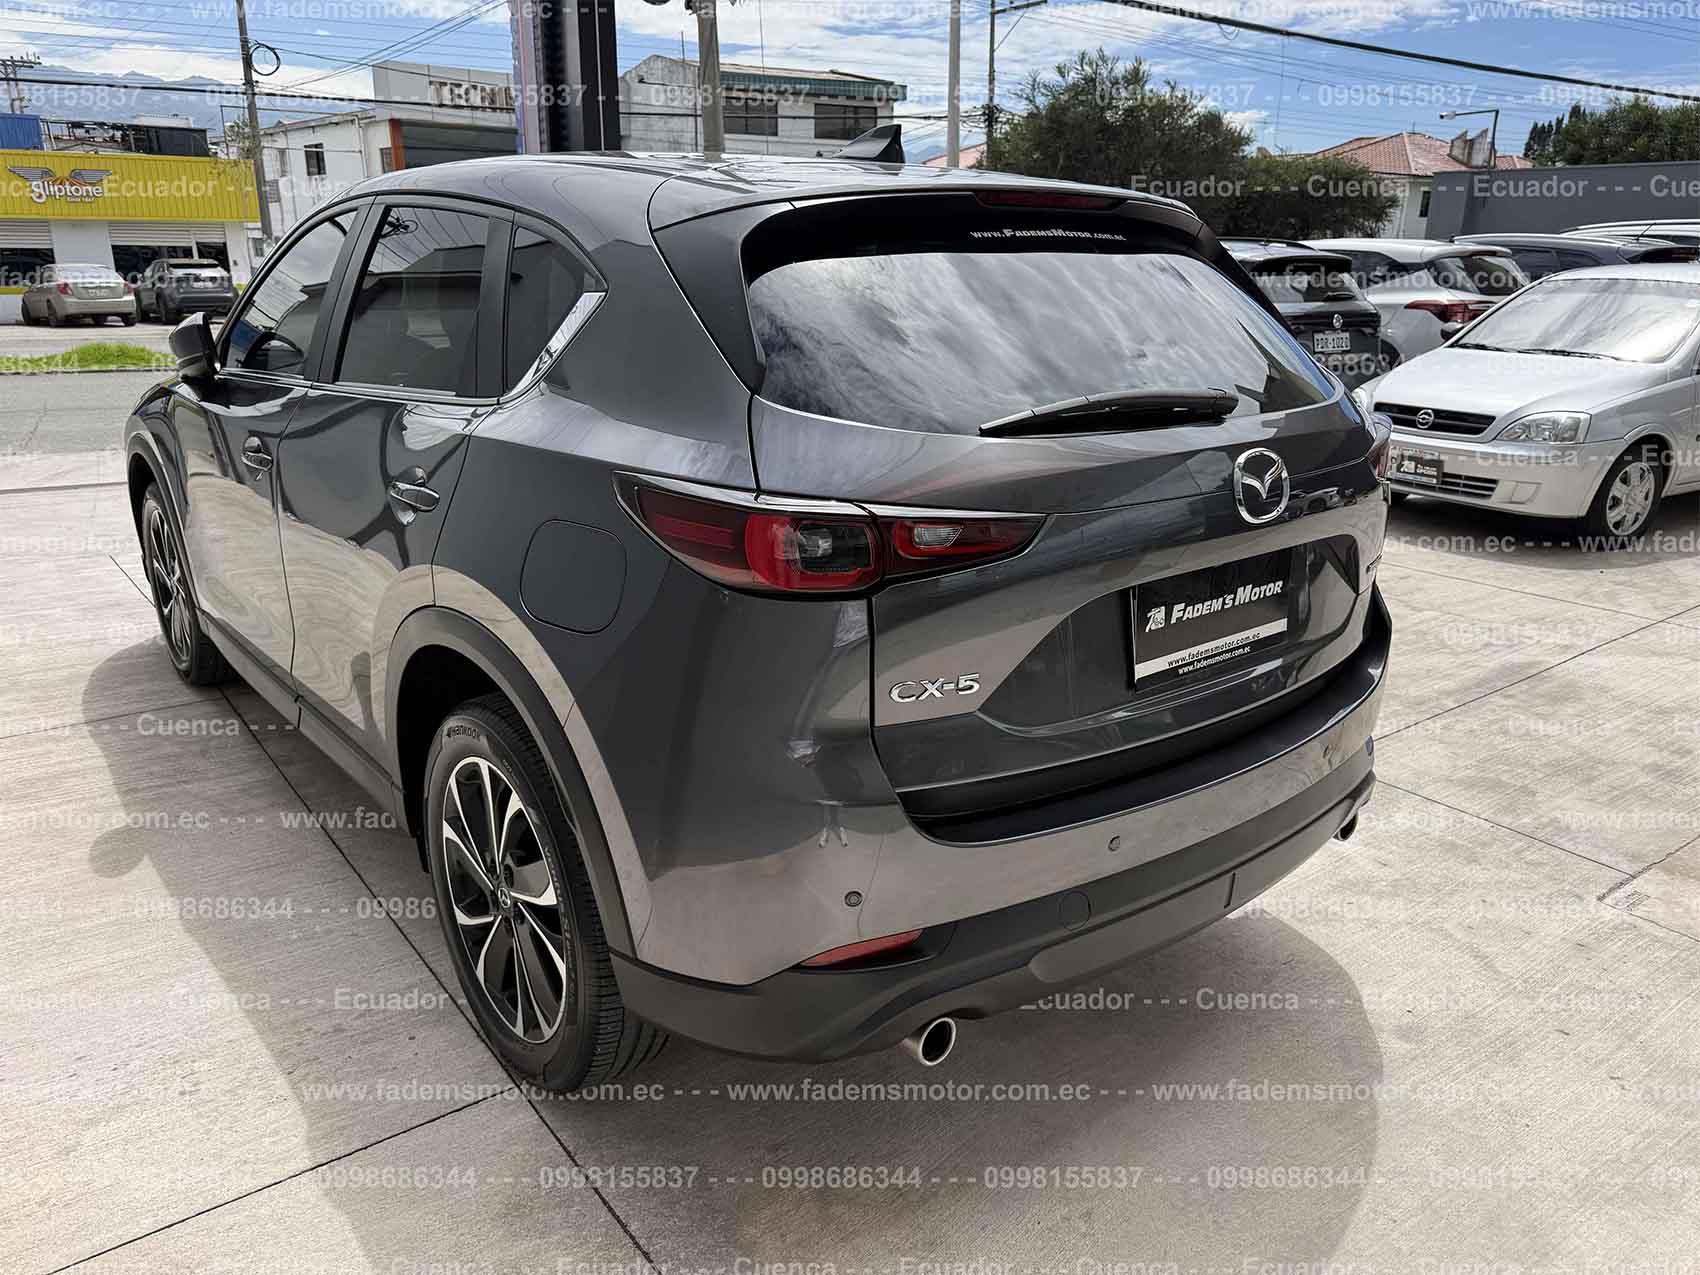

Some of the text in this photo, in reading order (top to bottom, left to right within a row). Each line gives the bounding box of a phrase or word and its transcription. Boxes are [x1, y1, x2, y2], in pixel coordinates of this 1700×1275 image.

[1166, 631, 1262, 668] www.fademsmotor.com.ec
[1177, 645, 1252, 676] www.fademsmotor.com.ec
[889, 672, 980, 703] CX-5
